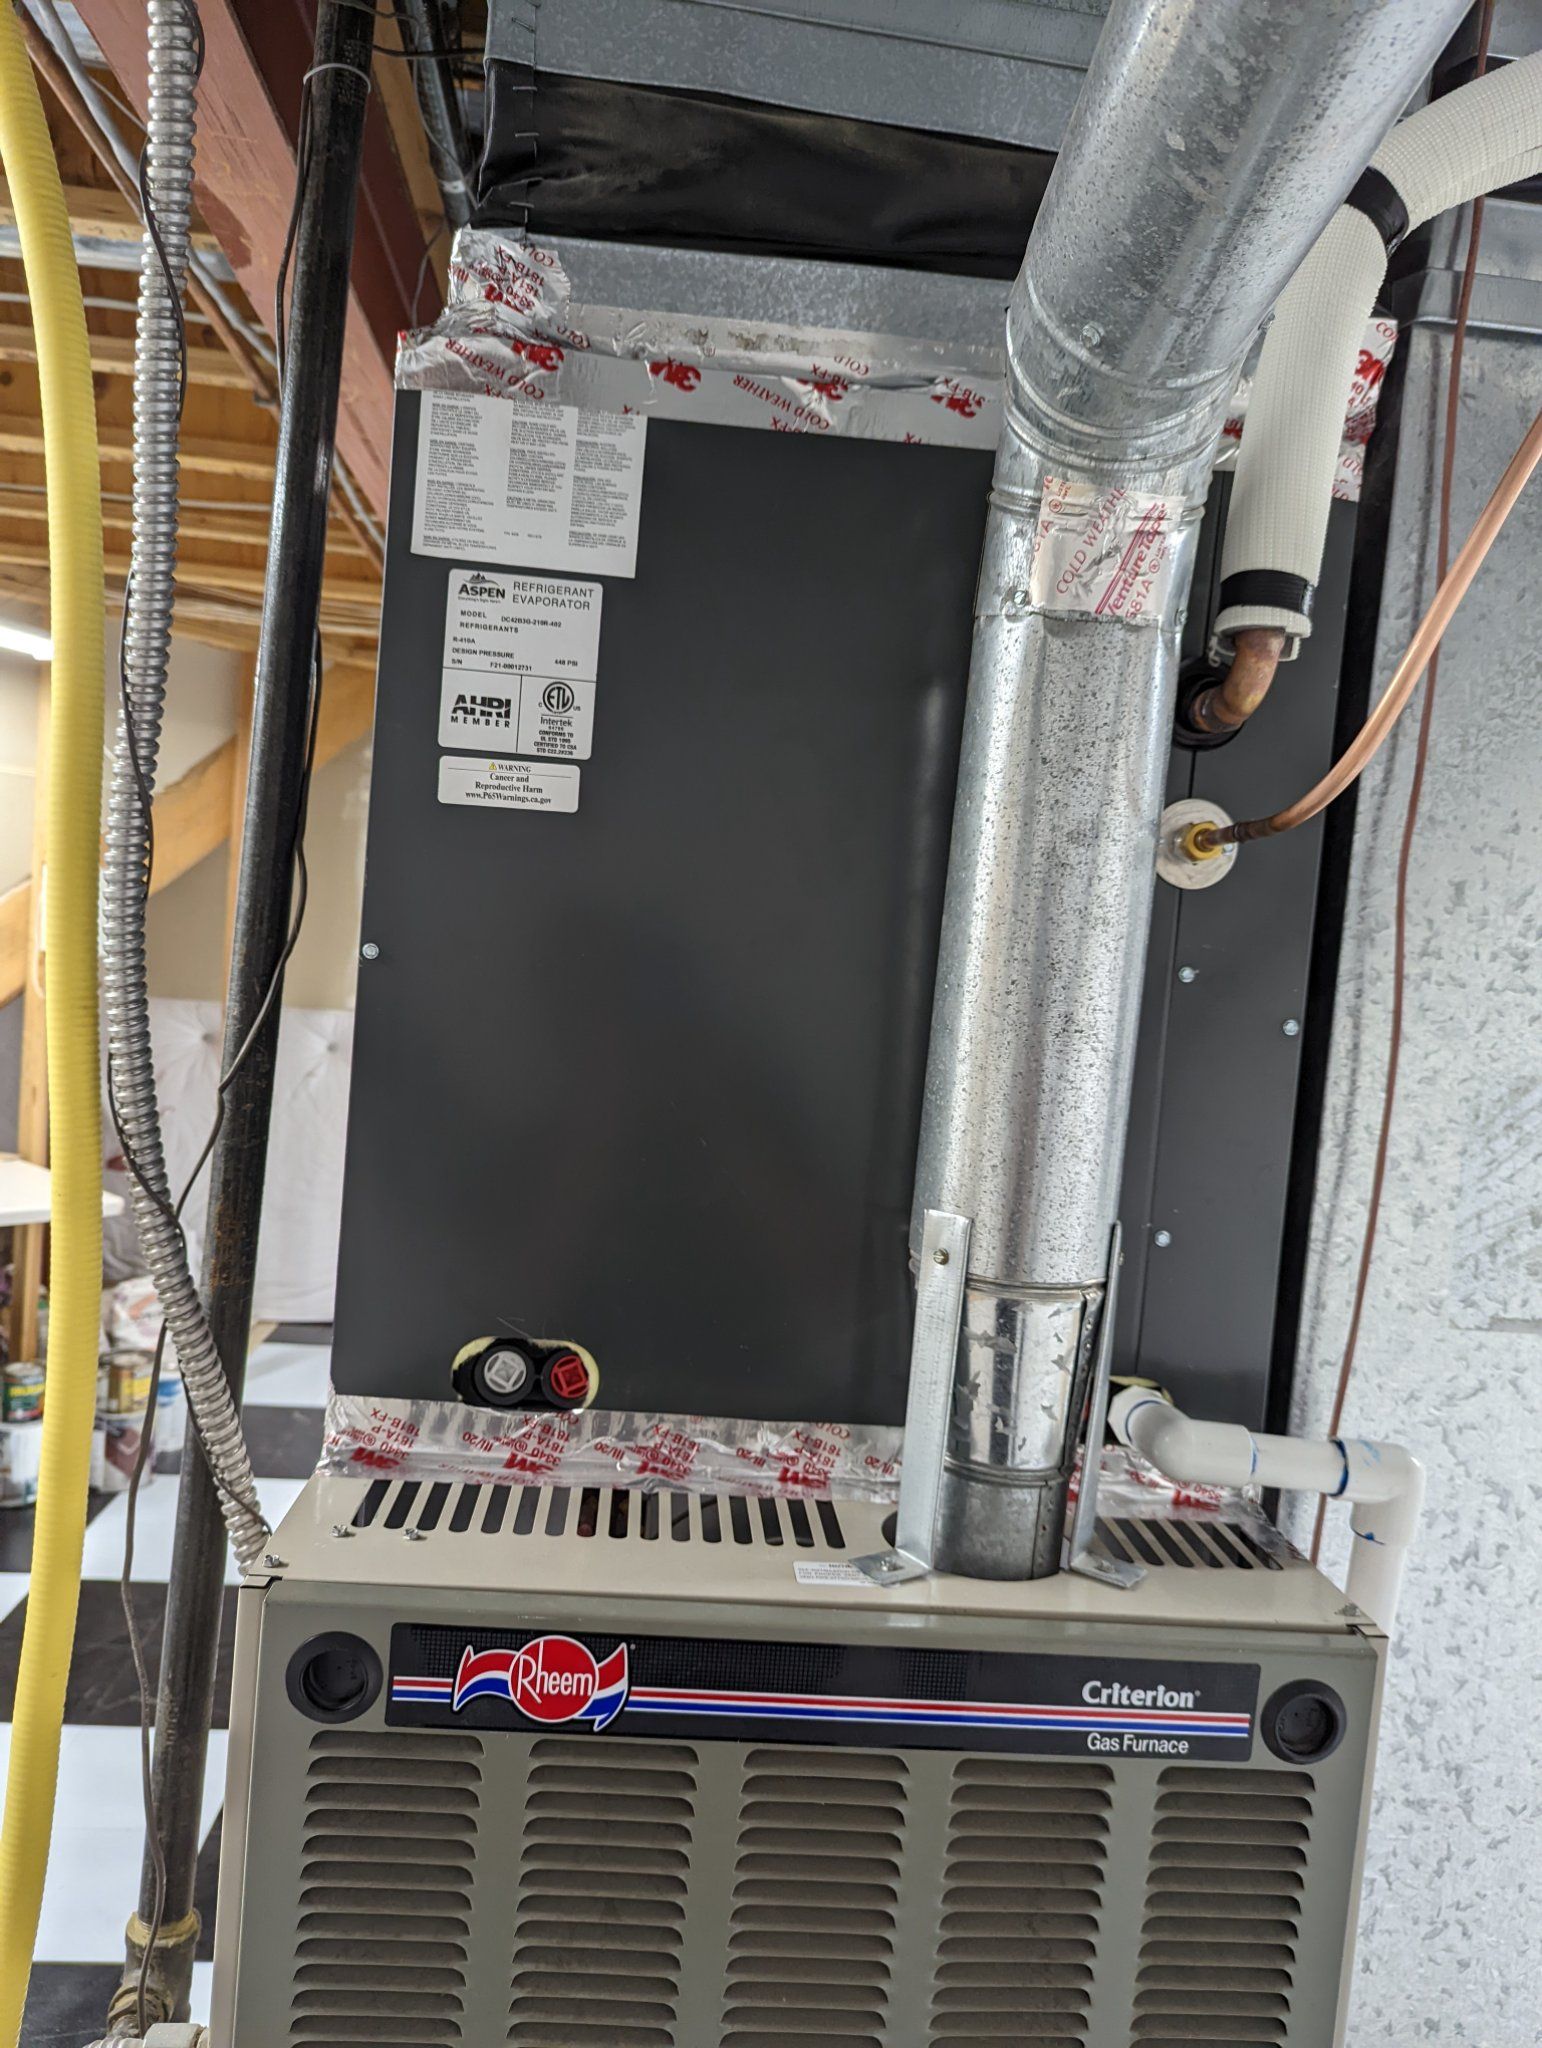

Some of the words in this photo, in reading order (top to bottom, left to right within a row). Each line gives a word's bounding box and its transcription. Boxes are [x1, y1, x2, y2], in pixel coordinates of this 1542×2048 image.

[445, 337, 505, 380] WEATHER
[508, 374, 546, 401] COLD
[732, 374, 792, 412] WEATHER
[794, 405, 831, 431] COLD
[1056, 549, 1087, 595] COLD
[458, 583, 506, 599] ASPEN
[513, 582, 594, 599] REFRIGERANT
[512, 594, 590, 611] EVAPORATOR
[460, 609, 487, 619] MODEL
[460, 621, 519, 634] REFRIGERANTS
[453, 636, 476, 644] R-410A
[452, 647, 478, 656] DESIGN
[479, 649, 515, 659] PRESSURE
[450, 715, 511, 728] MEMBER
[540, 716, 573, 727] Intertek
[490, 773, 513, 783] Cancer
[515, 775, 529, 783] and
[498, 764, 531, 773] WARNING
[475, 781, 521, 795] Reproductive
[522, 785, 543, 794] Harm
[465, 791, 551, 805] www.P65Warnings.ca.gov
[370, 1408, 420, 1437] 181B-FX
[371, 1425, 415, 1449] 181A-P
[522, 1431, 566, 1454] 181A-P
[793, 1430, 841, 1457] 181B-FX
[380, 1441, 409, 1460] 3340
[531, 1447, 562, 1467] 3340
[516, 1640, 595, 1704] Rheem
[1082, 1680, 1195, 1708] Criterion
[1087, 1732, 1120, 1751] Gas
[1123, 1734, 1189, 1754] Furnace
